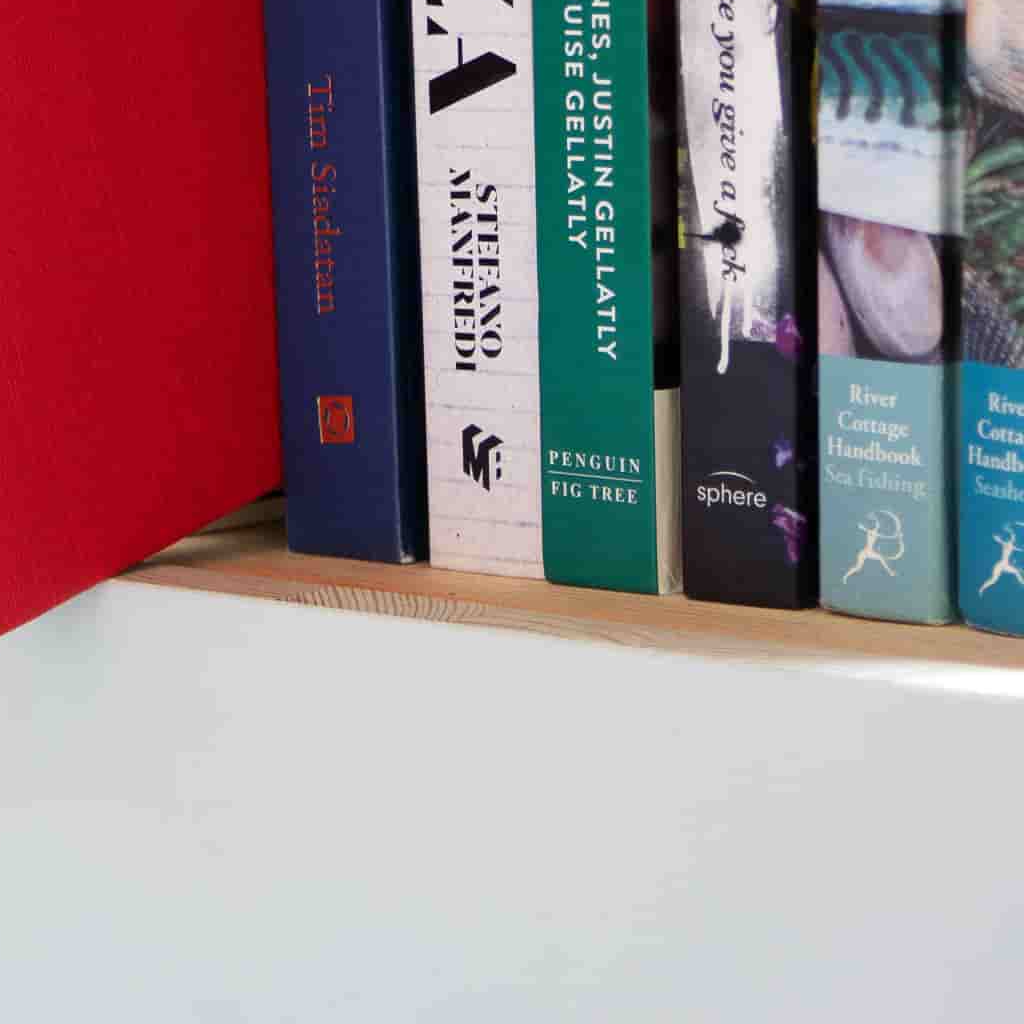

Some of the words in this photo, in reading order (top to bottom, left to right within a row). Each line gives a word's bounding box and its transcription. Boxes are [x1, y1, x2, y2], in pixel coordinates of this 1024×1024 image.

[711, 23, 738, 94] you
[307, 72, 336, 150] Tim
[592, 72, 614, 188] JUSTIN
[712, 98, 745, 172] give
[565, 90, 588, 250] GELLATLY
[720, 181, 738, 200] a
[311, 161, 344, 316] Siadatan
[449, 168, 477, 372] MANFREDI
[476, 183, 503, 359] STEFANO
[712, 200, 747, 283] fck
[595, 200, 617, 361] GELLATLY
[838, 411, 911, 441] Cottage
[849, 383, 898, 409] River
[548, 450, 642, 474] PENGUIN
[825, 465, 854, 488] Sea
[827, 435, 921, 466] Handbook
[551, 480, 582, 499] FIG
[589, 485, 639, 504] TREE
[697, 482, 768, 509] sphere
